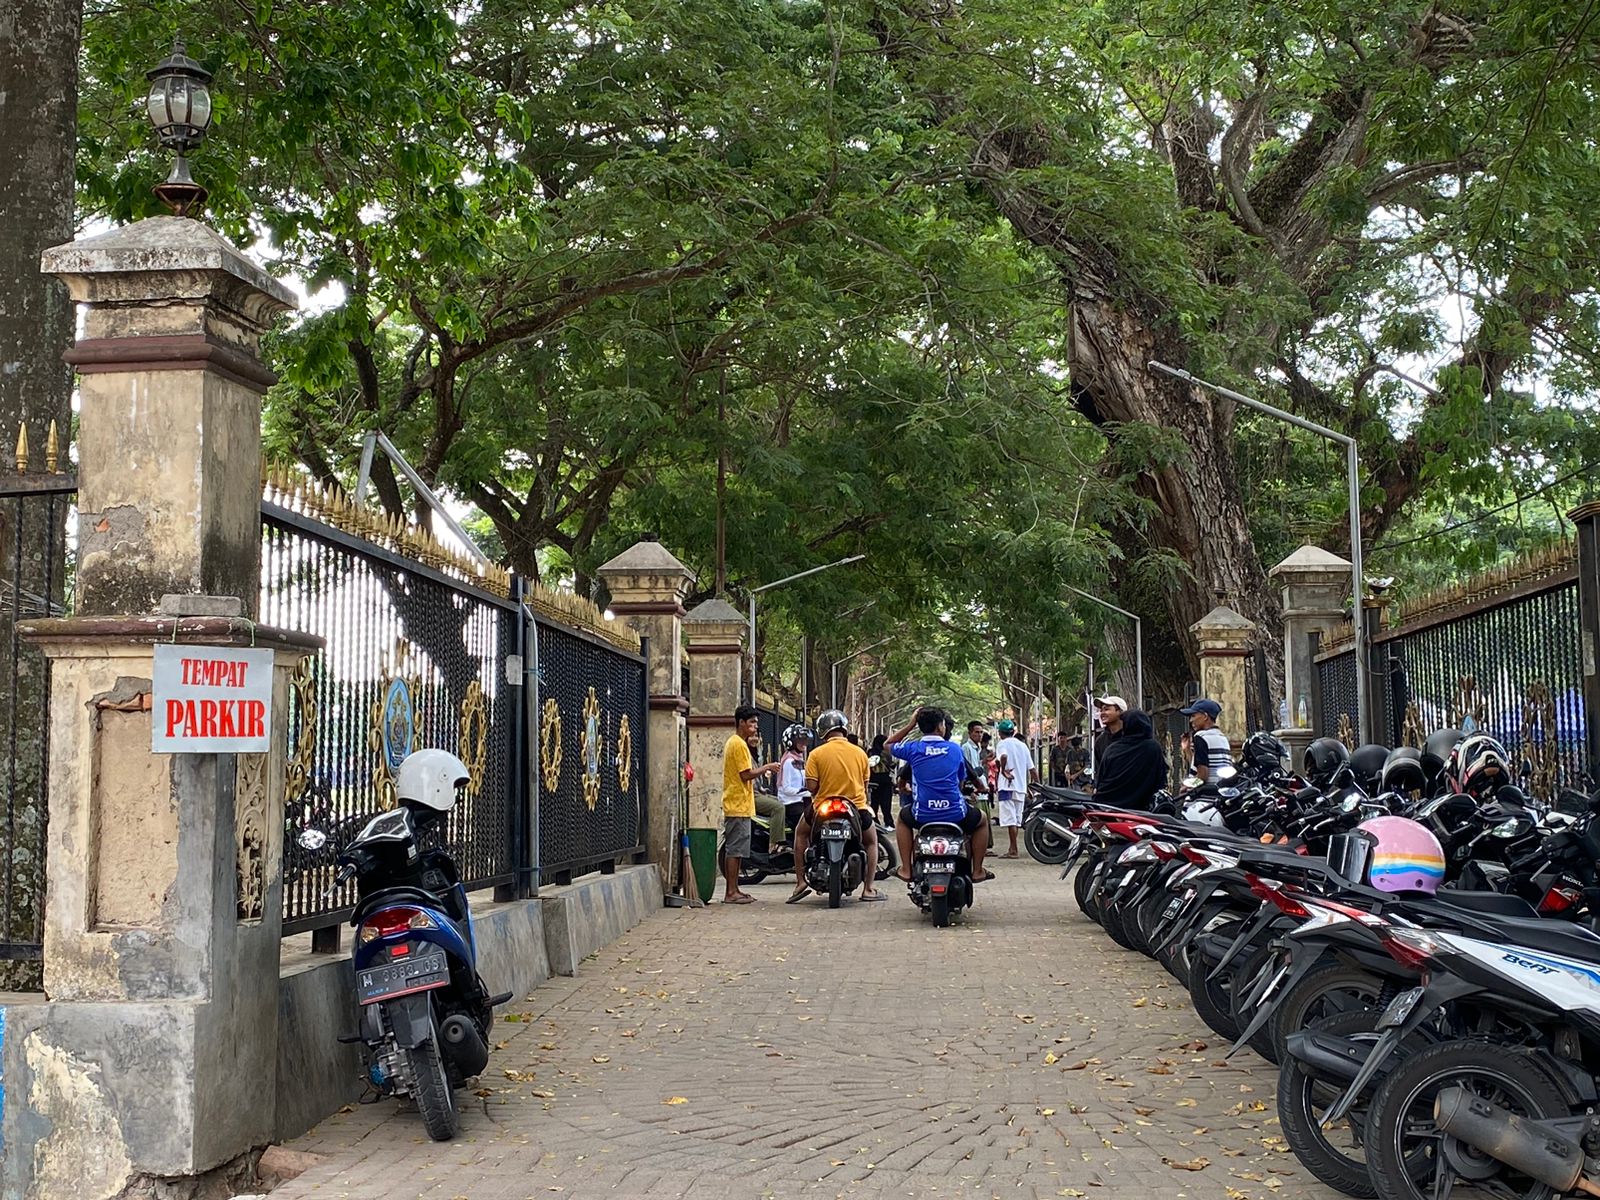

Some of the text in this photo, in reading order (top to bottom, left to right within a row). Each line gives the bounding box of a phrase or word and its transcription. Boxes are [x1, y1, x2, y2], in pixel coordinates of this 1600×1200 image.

[180, 658, 249, 688] TEMPAT
[165, 699, 266, 738] PARKIR
[928, 799, 950, 808] FWD
[362, 973, 373, 987] M
